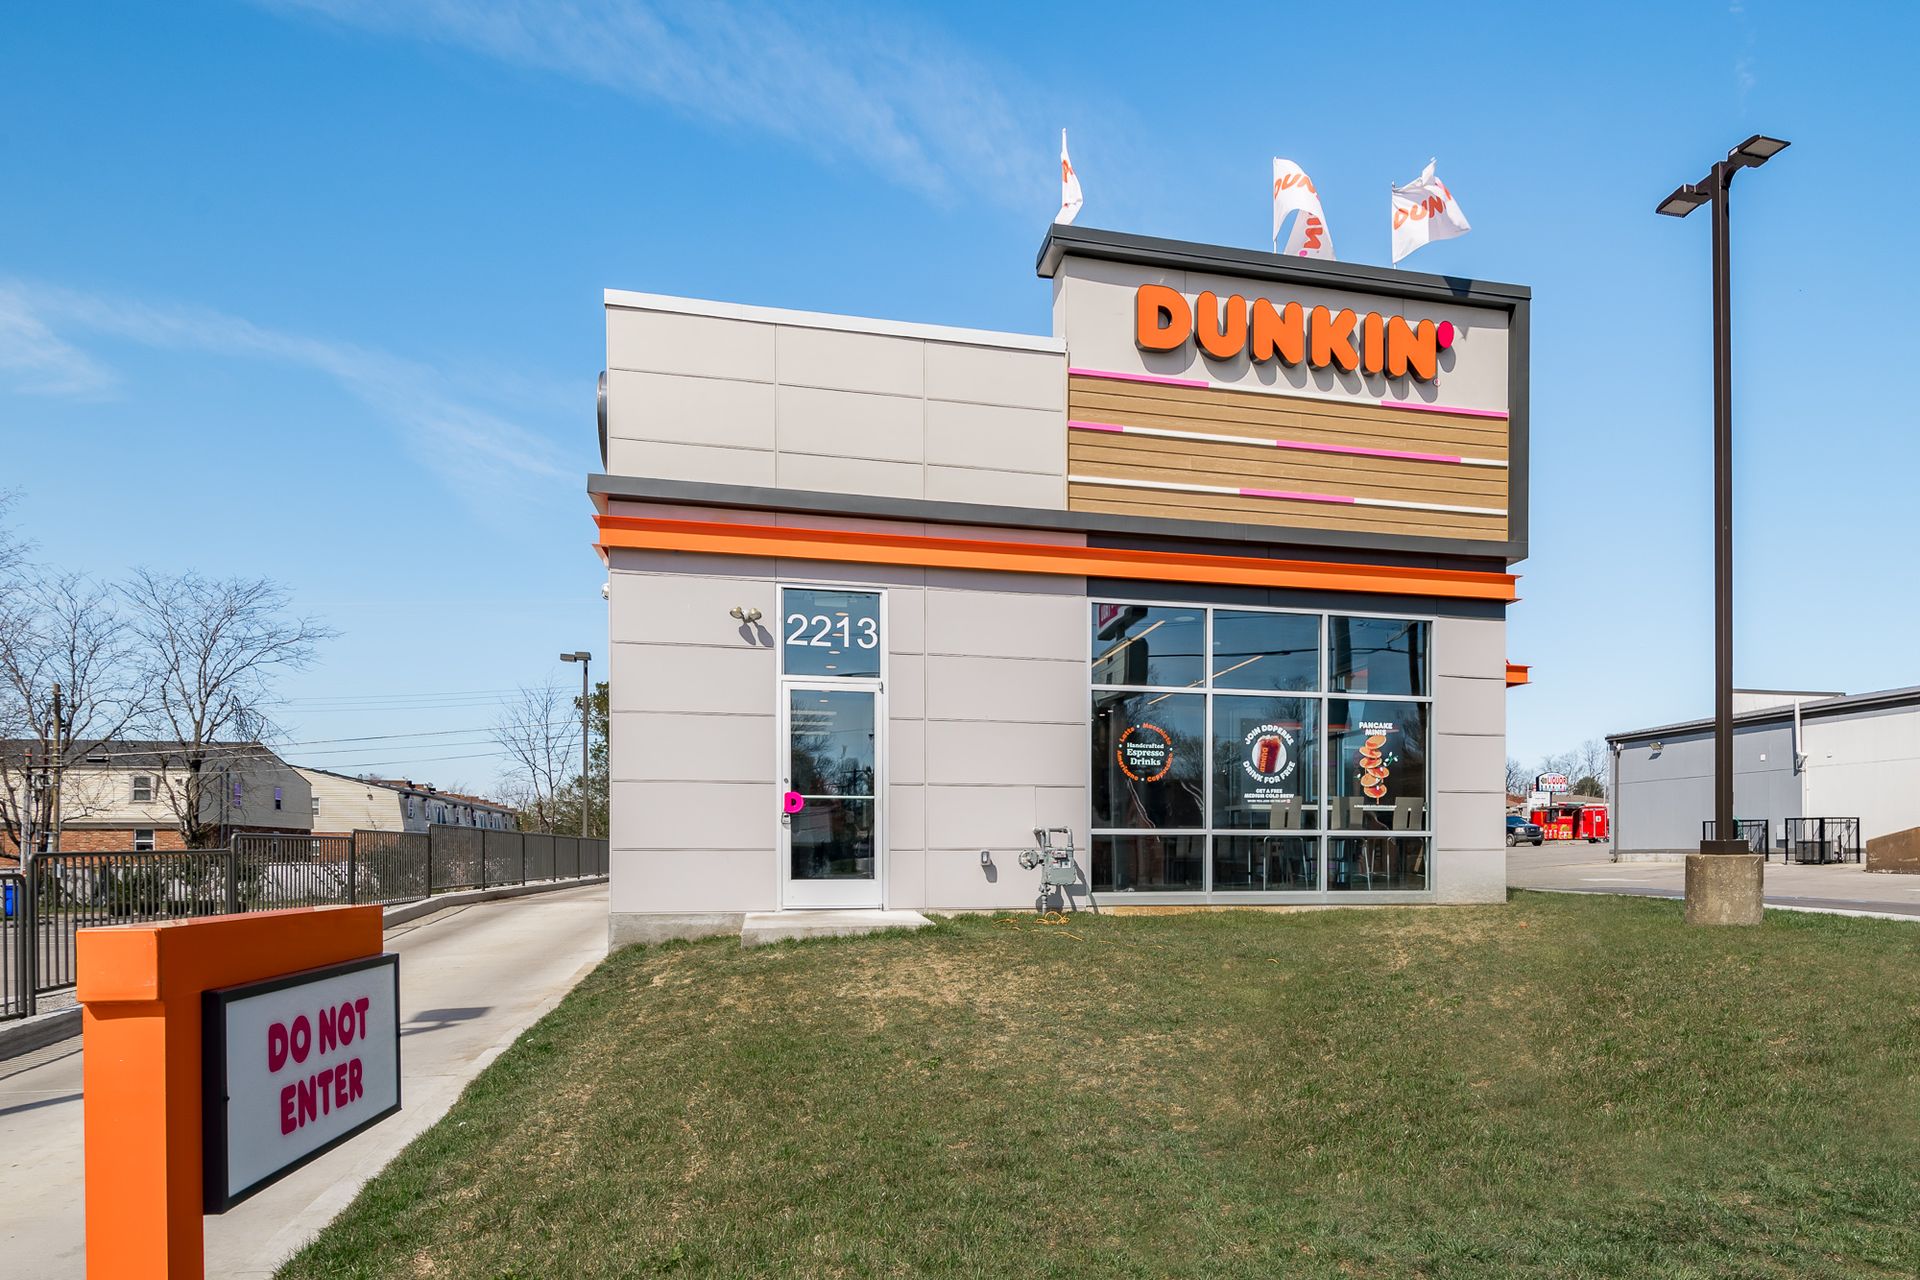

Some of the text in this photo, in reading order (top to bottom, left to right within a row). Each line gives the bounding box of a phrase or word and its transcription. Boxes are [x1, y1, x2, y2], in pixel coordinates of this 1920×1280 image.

[1136, 284, 1454, 381] DUNKIN'
[786, 613, 879, 649] 2213
[1120, 727, 1135, 742] Latte
[1245, 726, 1261, 745] JOIN
[1358, 721, 1393, 730] PANCAKE
[1126, 748, 1165, 758] Espresso
[1130, 757, 1161, 766] Drinks
[1117, 750, 1139, 781] Americano
[1243, 760, 1296, 784] DRINK FOR FREE
[267, 997, 369, 1073] DO NOT
[280, 1057, 363, 1135] ENTER
